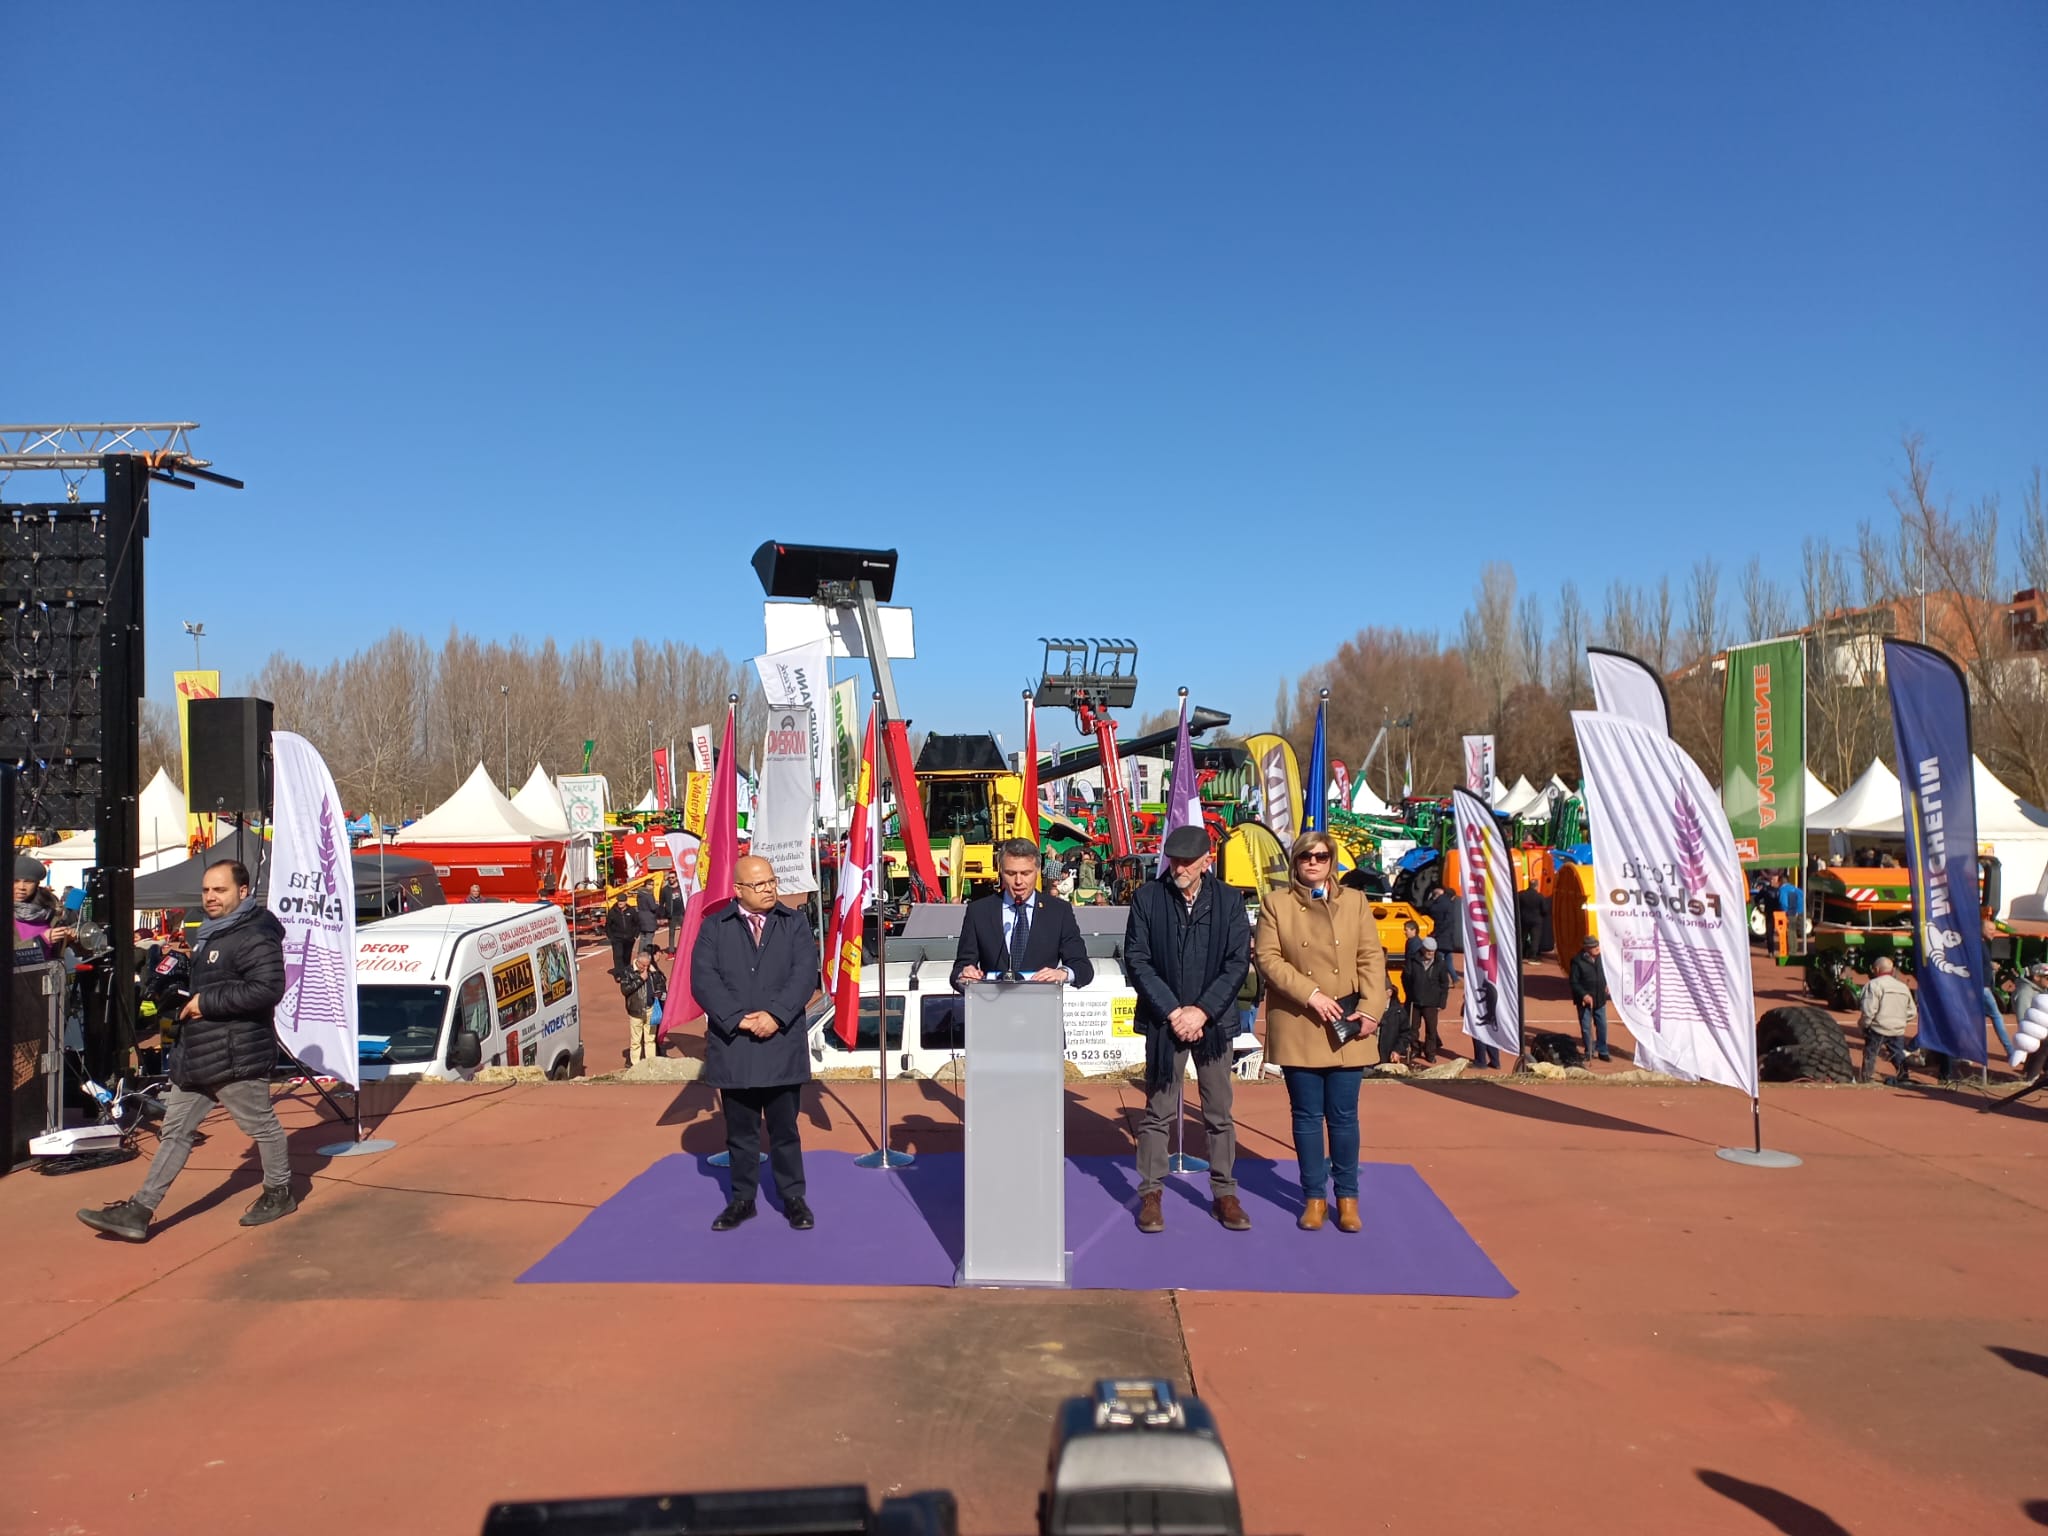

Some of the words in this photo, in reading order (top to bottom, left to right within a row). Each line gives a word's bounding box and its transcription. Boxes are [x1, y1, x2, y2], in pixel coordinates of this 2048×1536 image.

[359, 943, 410, 954] DECOR
[356, 955, 423, 973] eitosa
[1063, 1050, 1078, 1060] 19
[1081, 1050, 1100, 1060] 523
[1102, 1050, 1122, 1060] 659
